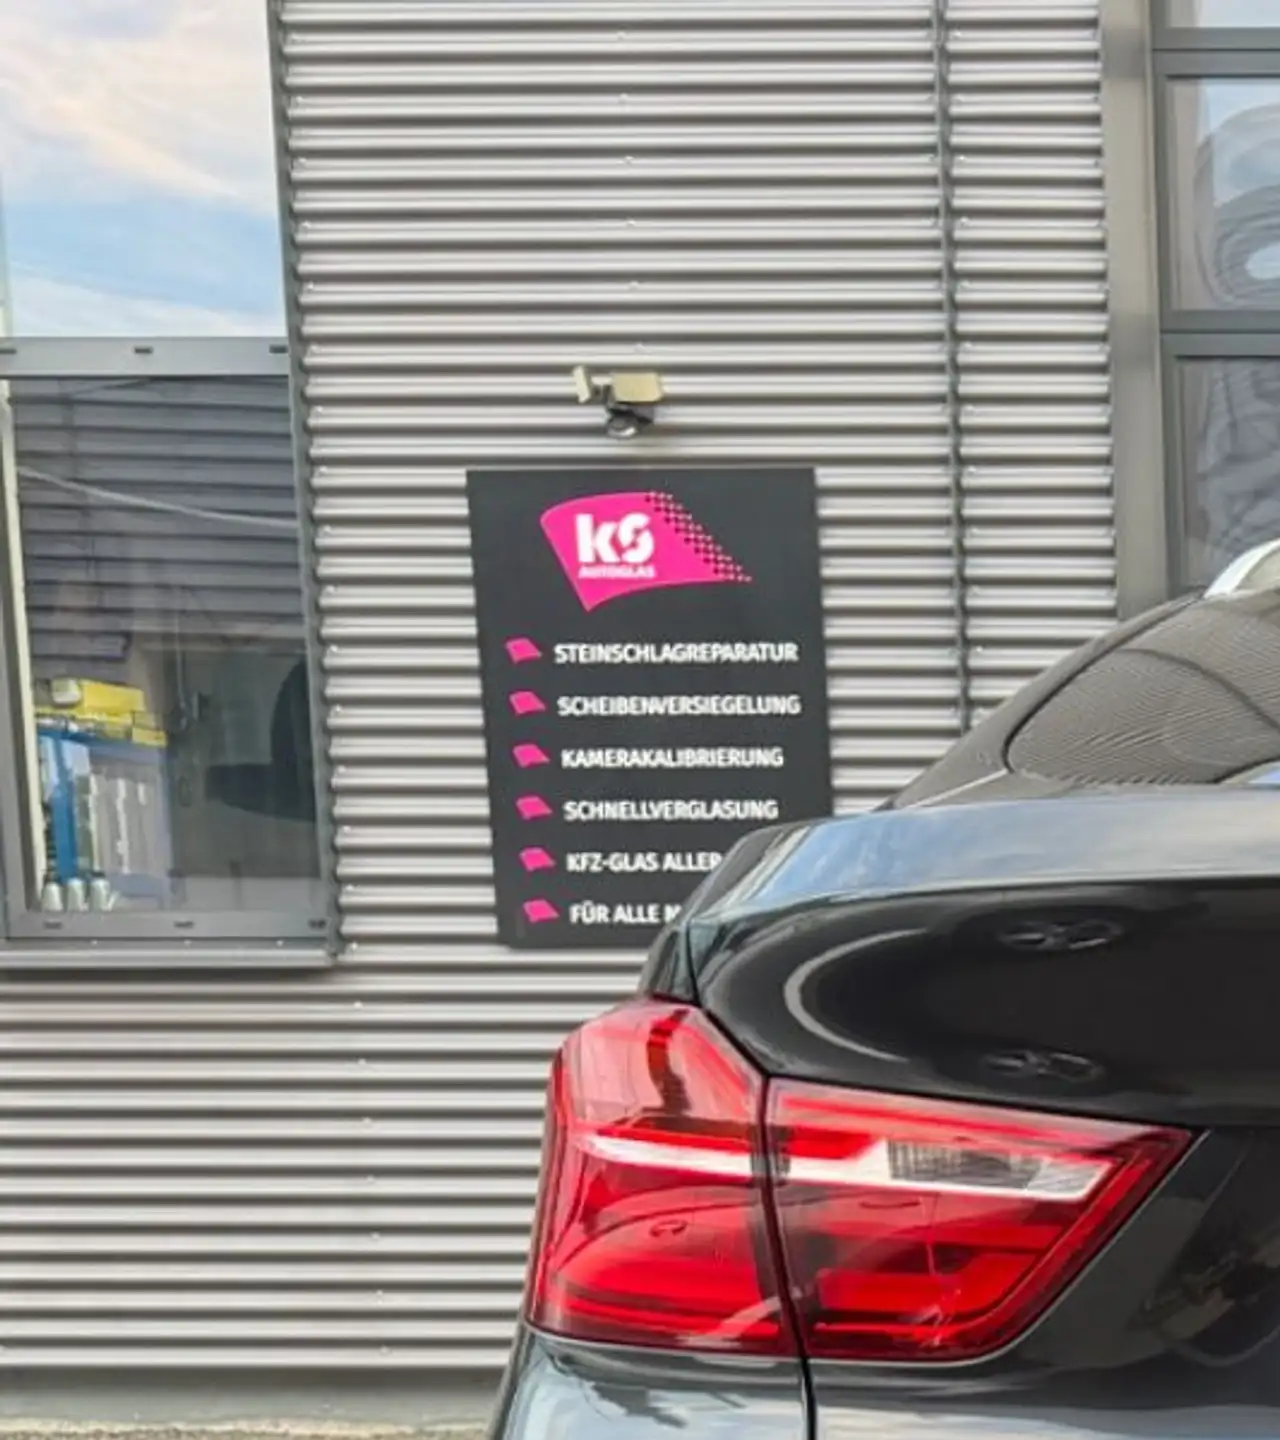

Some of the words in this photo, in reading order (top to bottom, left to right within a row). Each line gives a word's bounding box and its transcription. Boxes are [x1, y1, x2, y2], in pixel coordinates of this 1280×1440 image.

[554, 643, 799, 664] STEINSCHLAGREPARATUR
[557, 695, 801, 716] SCHEIBENVERSIEGELUNG
[561, 747, 784, 769] KAMERAKALIBRIERUNG
[563, 800, 779, 821] SCHNELLVERGLASUNG
[566, 852, 659, 873] KFZ-GLAS
[569, 900, 610, 924] FÜR
[613, 904, 660, 923] ALLE
